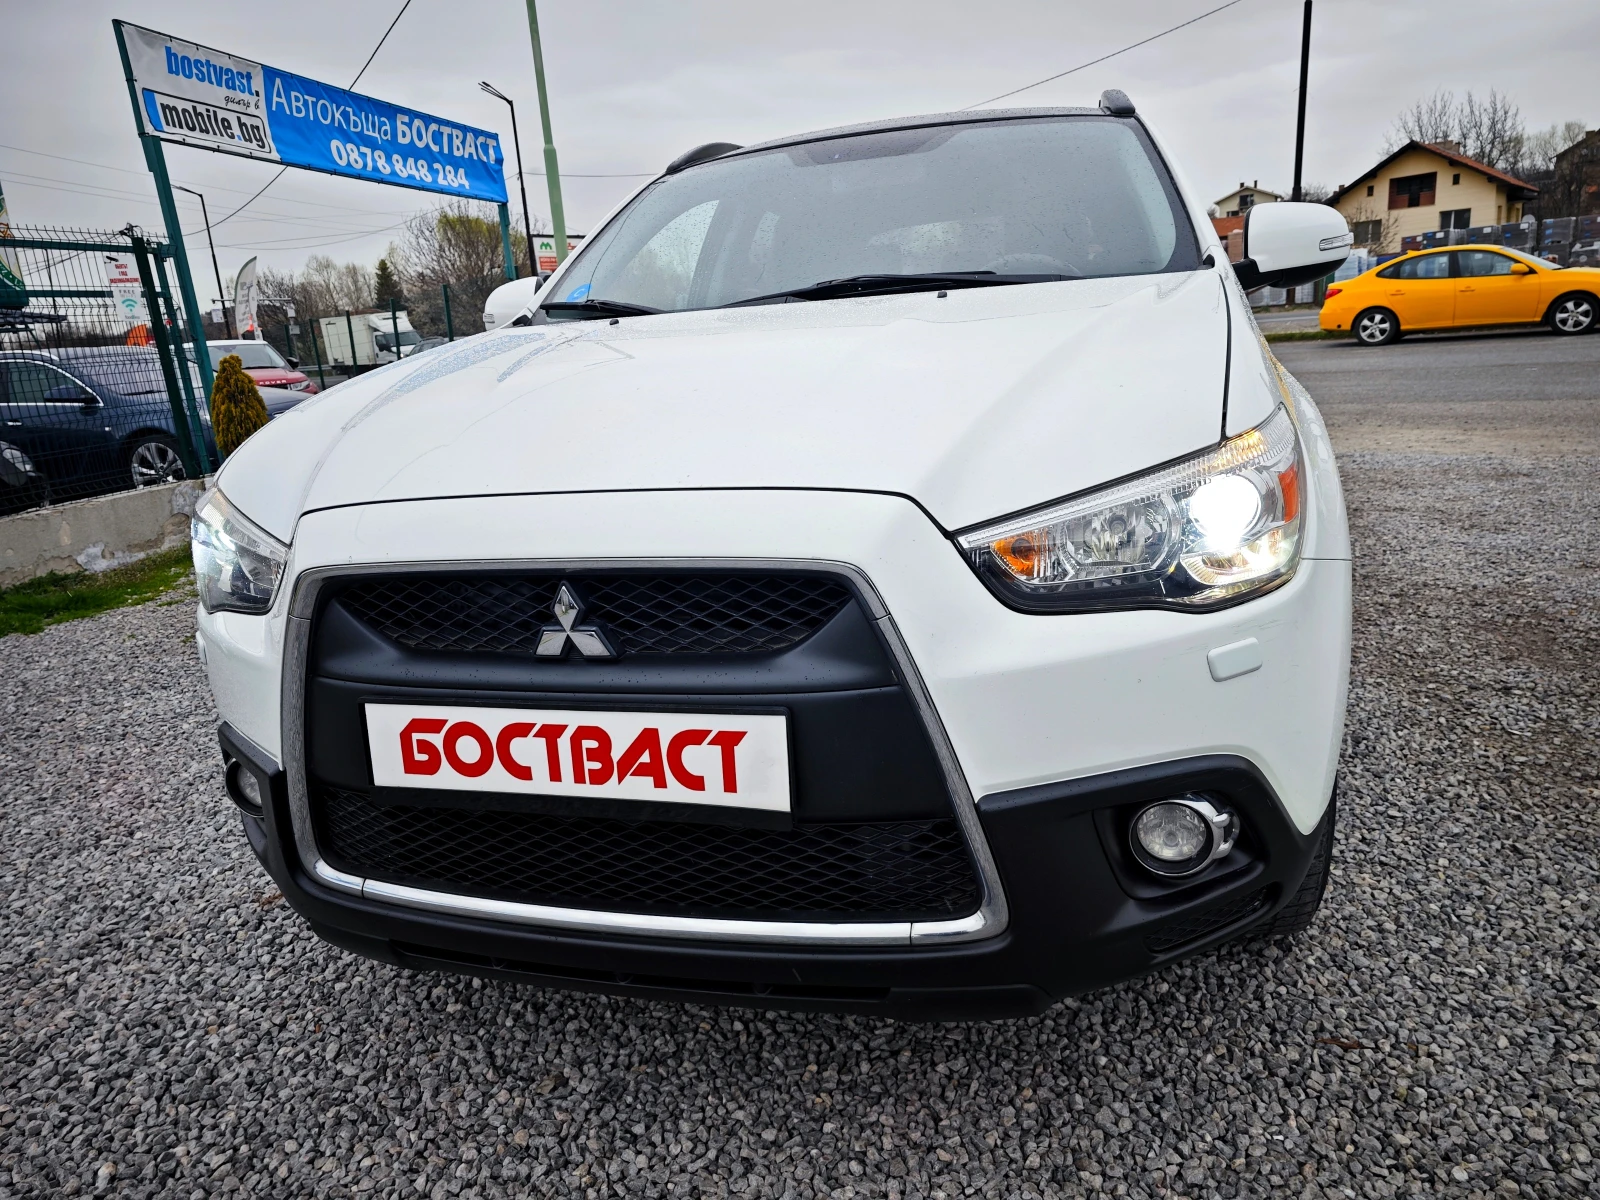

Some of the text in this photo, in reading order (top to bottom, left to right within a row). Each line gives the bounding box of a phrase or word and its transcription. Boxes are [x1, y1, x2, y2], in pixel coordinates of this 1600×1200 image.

[160, 102, 266, 149] mobile.bg
[396, 113, 497, 164] БОСТВАСТ
[330, 139, 470, 190] 0878 848 284
[399, 718, 749, 794] БОСТВАСТ
